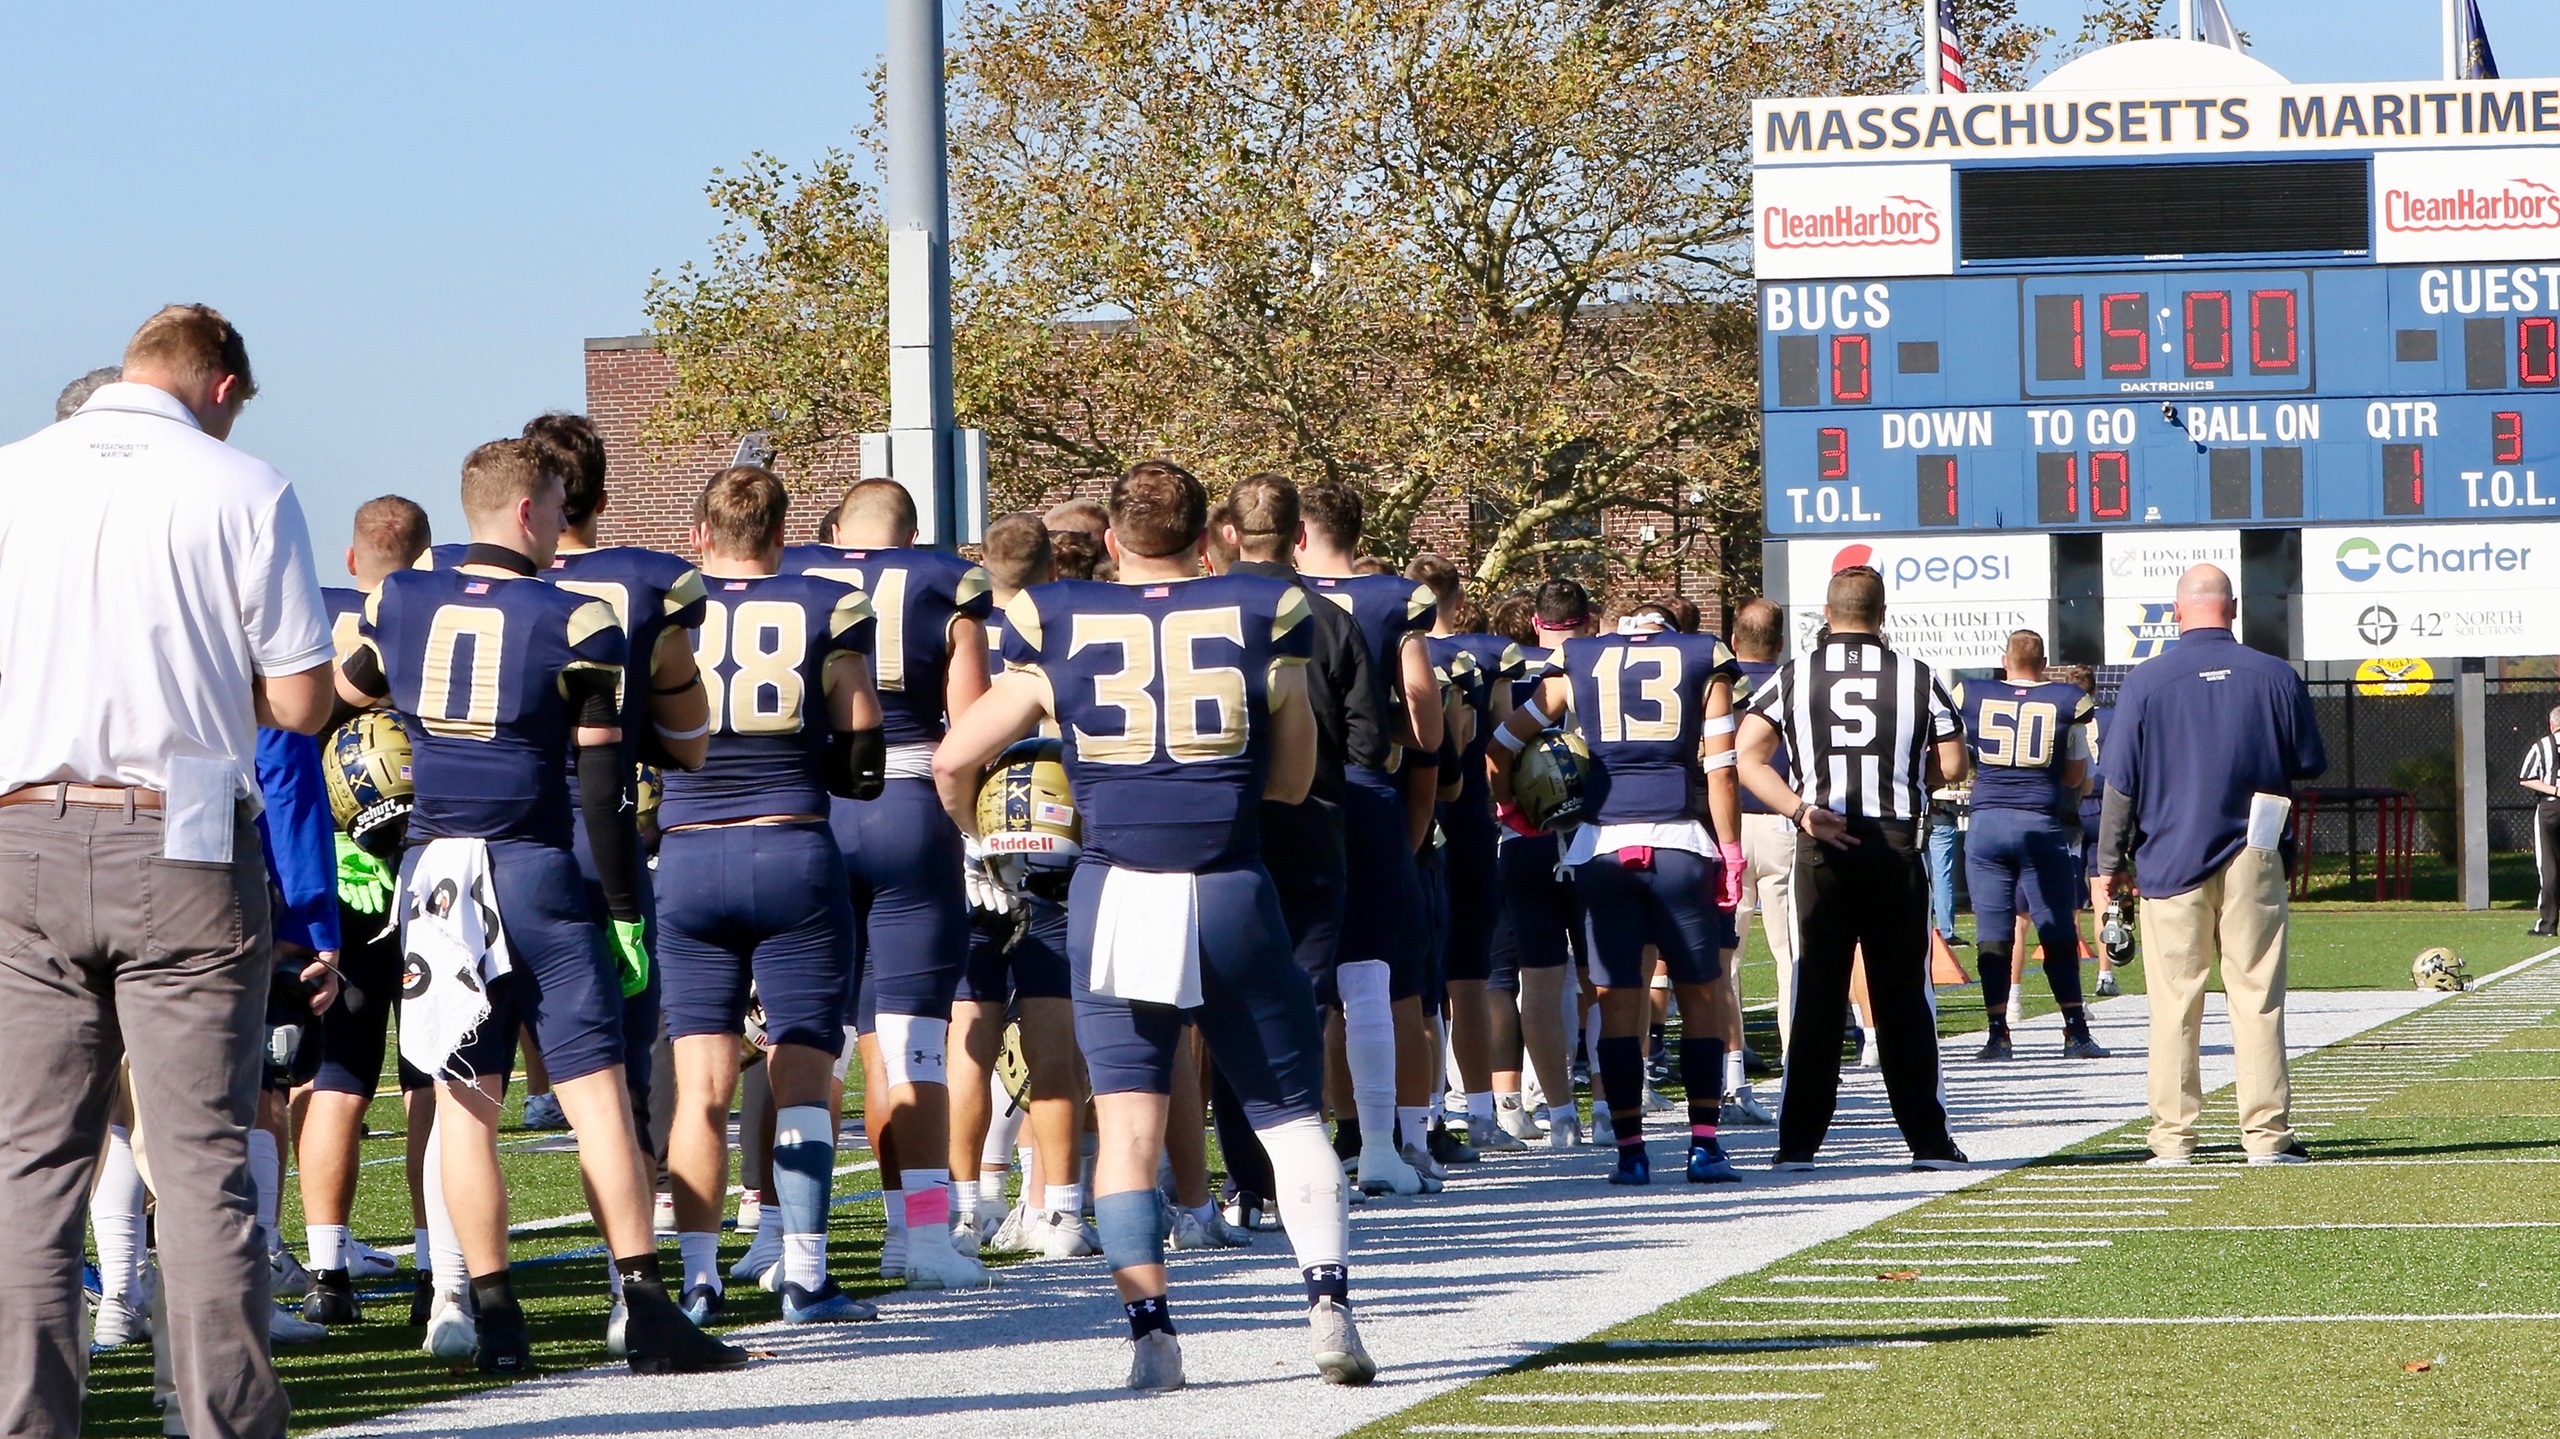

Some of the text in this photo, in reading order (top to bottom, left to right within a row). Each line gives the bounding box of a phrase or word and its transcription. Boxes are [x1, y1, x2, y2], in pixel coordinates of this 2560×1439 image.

[1765, 90, 2560, 155] MASSACHUSETTS MARITIME
[1764, 204, 1940, 249] CleanHarbors
[2385, 187, 2560, 232] CleanHarbors
[1766, 283, 1891, 331] BUCS
[2419, 266, 2560, 315] GUEST
[1832, 335, 1869, 400] 0
[2518, 317, 2556, 383] 0
[2120, 380, 2215, 392] DAKTRONICS
[1882, 410, 1993, 449] DOWN
[2027, 408, 2136, 446] TO GO
[2187, 404, 2320, 442] BALL ON
[2366, 401, 2439, 440] QTR
[2495, 411, 2522, 461] 3
[1821, 427, 1848, 478] 3
[1946, 459, 1956, 517] 1
[2066, 451, 2128, 518] 10
[2412, 448, 2422, 506] 1
[2460, 470, 2556, 508] T.O.L.
[1786, 486, 1881, 524] T.O.L.
[1895, 554, 2010, 591] pepsi
[2143, 547, 2238, 562] LONG BUILT
[2143, 565, 2190, 577] HOM
[2386, 541, 2532, 574] Charter
[1887, 629, 2012, 643] ARITIME ACADEM
[1888, 610, 2025, 628] ASSACHUSETTS
[2138, 625, 2179, 638] MARI
[2455, 610, 2523, 626] NORTH
[2455, 625, 2524, 636] SOLUTIONS
[417, 604, 504, 742] 0
[1067, 606, 1250, 765] 36
[1592, 645, 1683, 742] 13
[1830, 678, 1877, 748] S
[1977, 699, 2057, 768] 50
[990, 837, 1054, 852] Riddell
